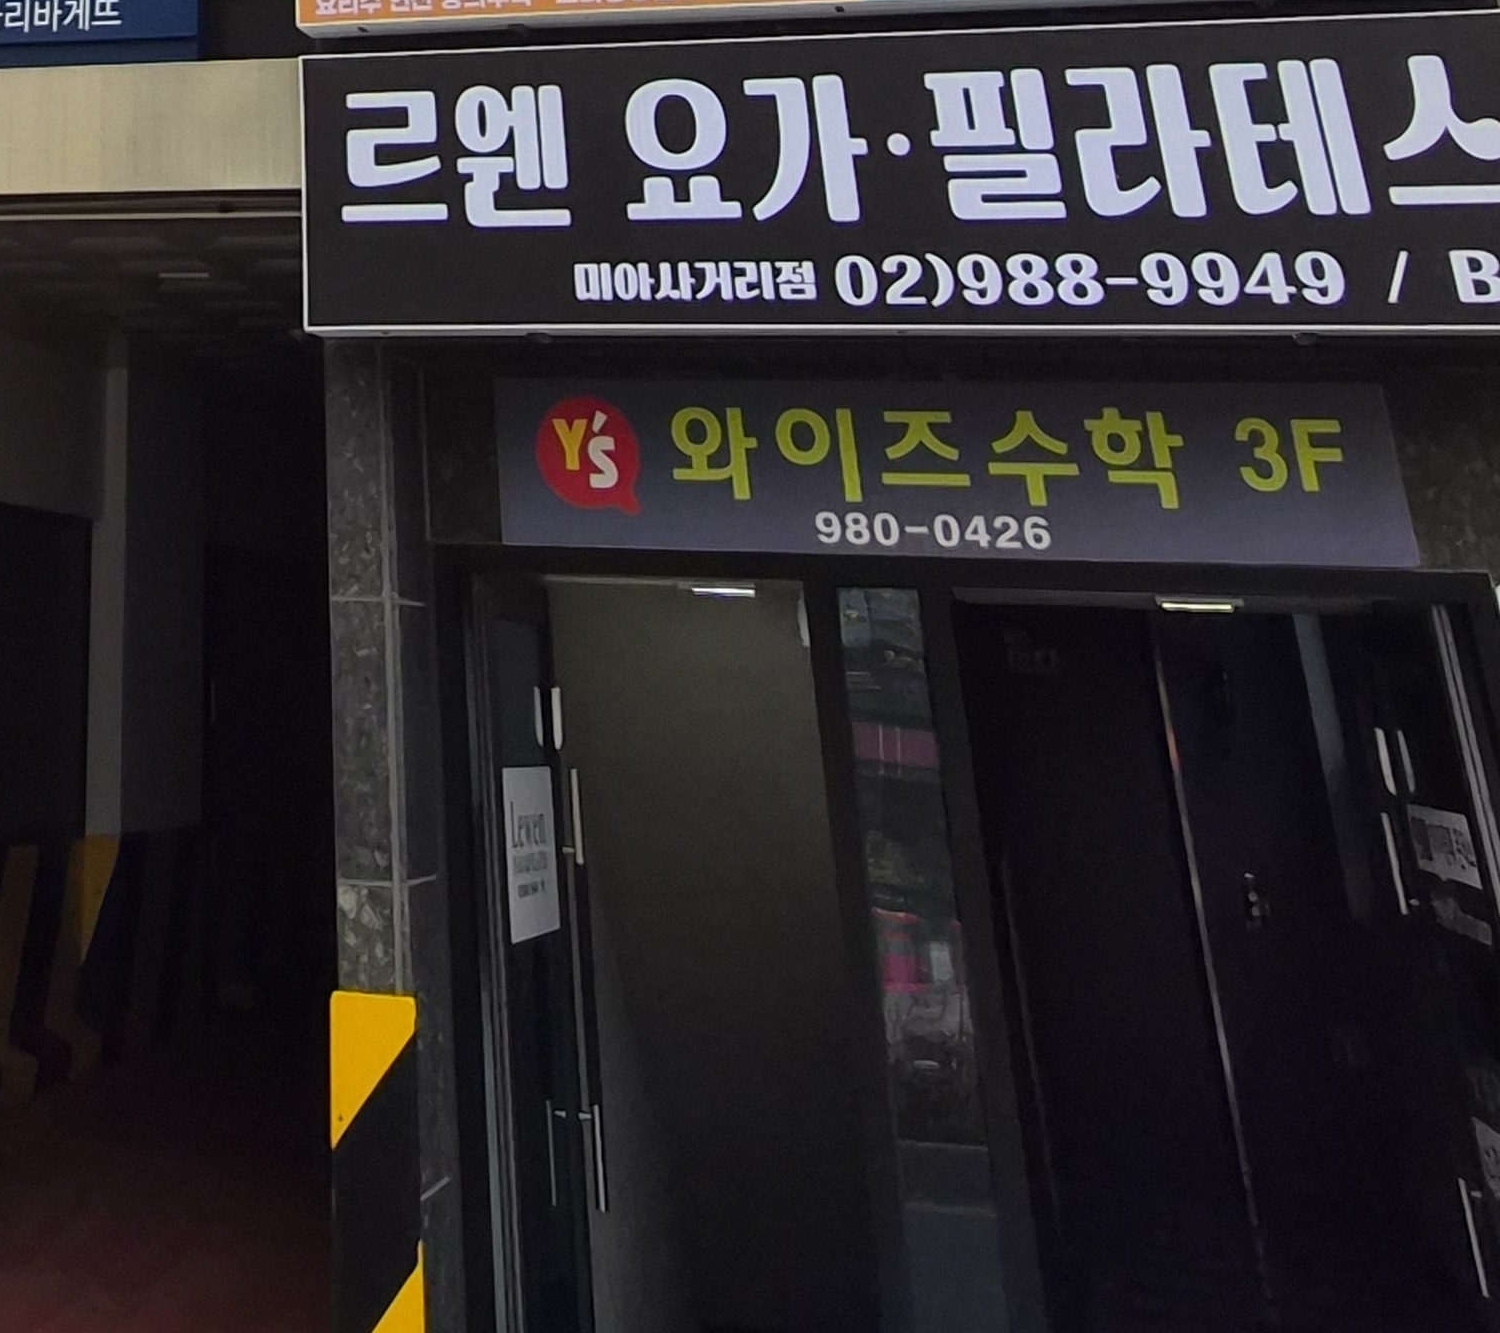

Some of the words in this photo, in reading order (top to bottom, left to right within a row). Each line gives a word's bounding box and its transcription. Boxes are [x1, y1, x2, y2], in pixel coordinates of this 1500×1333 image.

[341, 83, 572, 229] 르웬
[572, 260, 818, 303] 미아사거리점
[833, 249, 1347, 308] 02)988-9949
[552, 410, 620, 490] Y's
[668, 405, 1184, 510] 와이즈수학
[1233, 417, 1344, 494] 3F
[814, 510, 1053, 552] 980-0426
